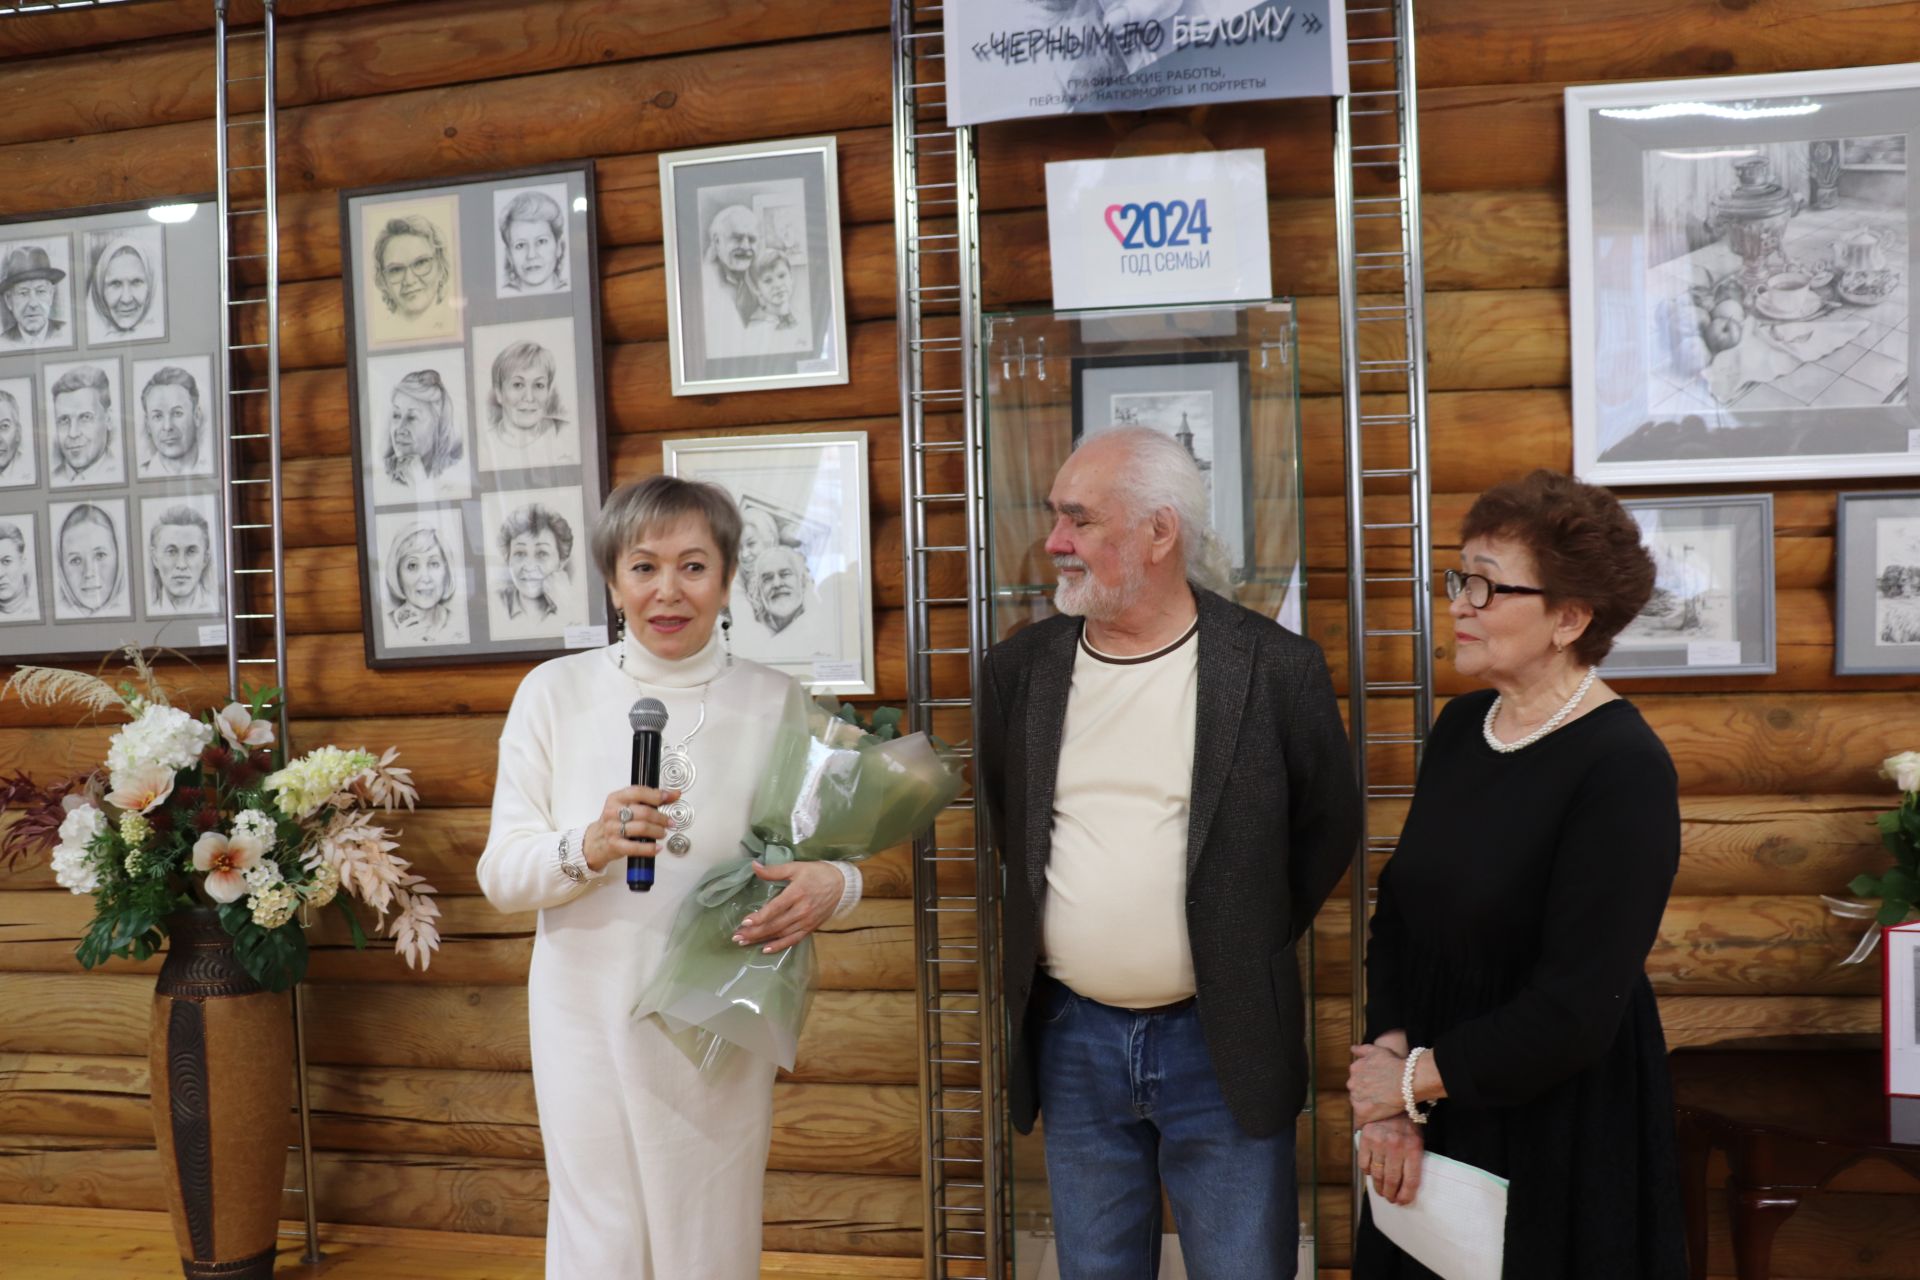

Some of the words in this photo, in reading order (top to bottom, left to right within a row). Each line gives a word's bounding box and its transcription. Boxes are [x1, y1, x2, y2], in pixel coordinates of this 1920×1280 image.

[1123, 19, 1160, 49] ПО
[1172, 5, 1292, 46] БЕЛОМУ
[1067, 71, 1162, 89] ГРАФИЧЕСКИЕ
[1166, 66, 1226, 82] РАБОТЫ,
[1096, 83, 1184, 101] НАТЮРМОРТЫ
[1187, 85, 1197, 94] И
[1200, 78, 1267, 92] ПОРТРЕТЫ
[1120, 198, 1212, 249] 2024
